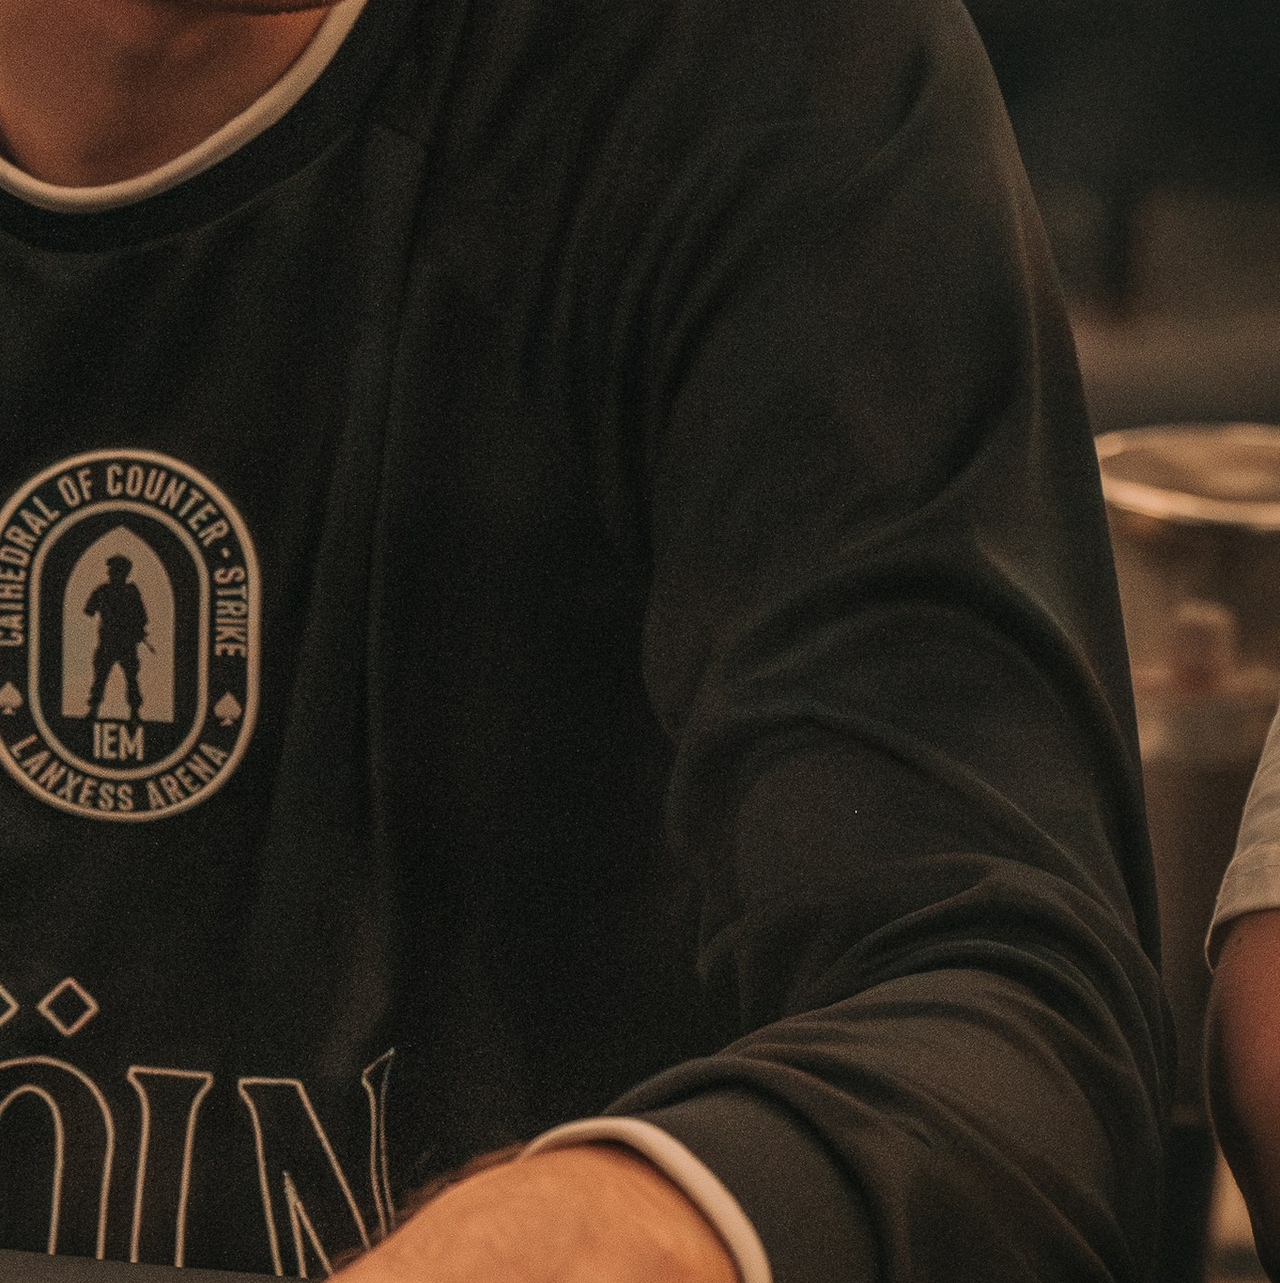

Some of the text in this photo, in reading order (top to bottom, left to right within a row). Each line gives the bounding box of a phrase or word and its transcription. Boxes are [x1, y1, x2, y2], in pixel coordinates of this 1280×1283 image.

[58, 467, 93, 507] OF
[92, 721, 145, 762] IEM
[10, 732, 228, 812] LANXESS ARENA
